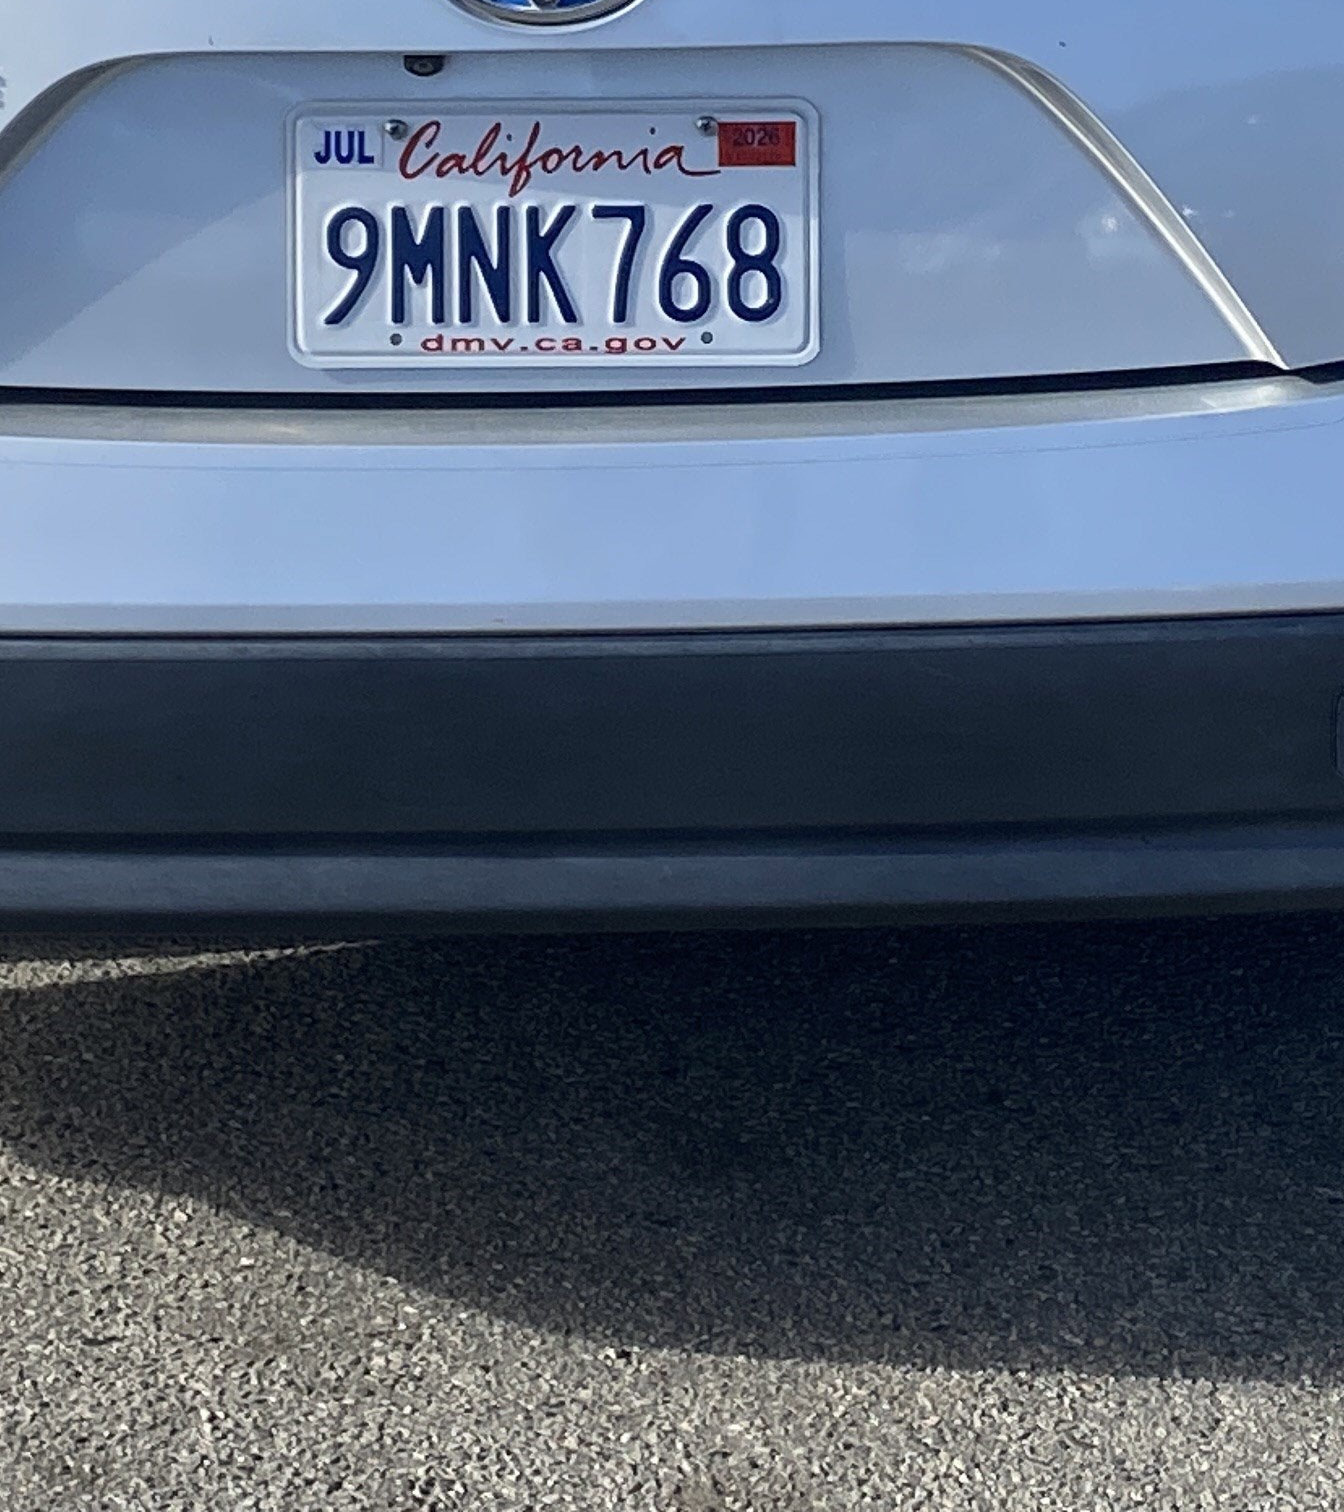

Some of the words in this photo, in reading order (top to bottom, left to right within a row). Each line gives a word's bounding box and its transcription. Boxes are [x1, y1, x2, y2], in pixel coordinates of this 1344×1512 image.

[314, 131, 374, 164] JUL
[398, 120, 721, 197] California
[324, 203, 782, 324] 9MNK768
[420, 332, 687, 354] dmv.ca.gov
